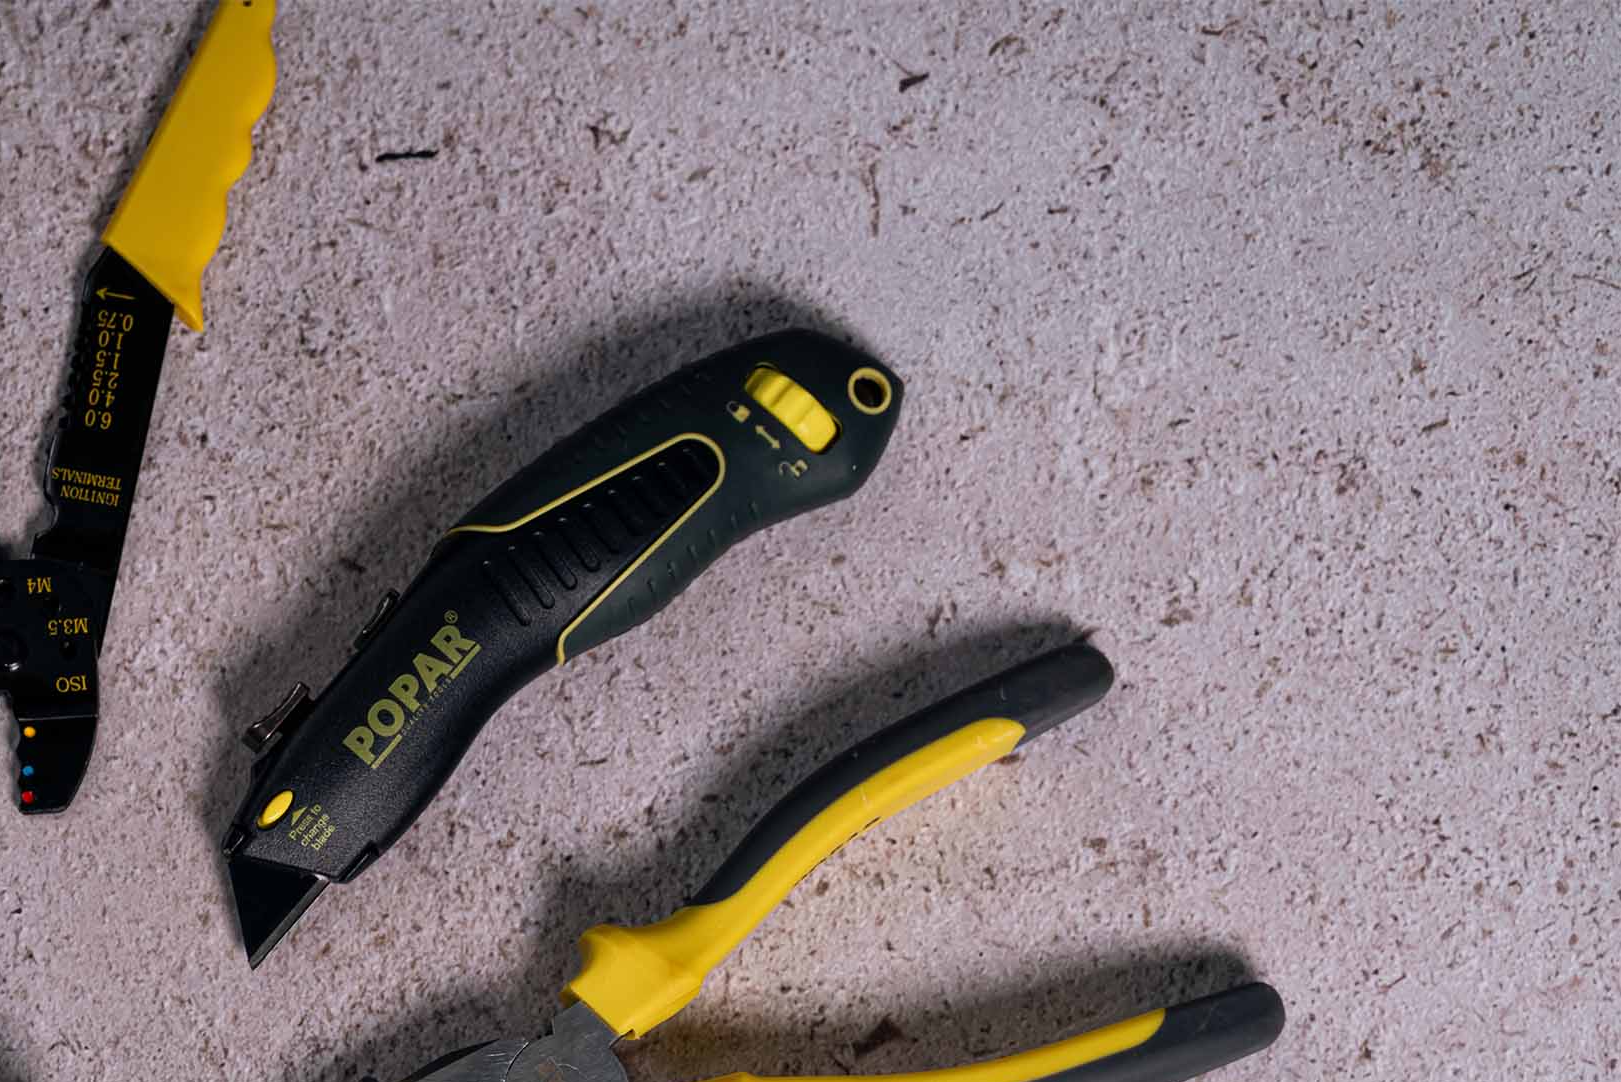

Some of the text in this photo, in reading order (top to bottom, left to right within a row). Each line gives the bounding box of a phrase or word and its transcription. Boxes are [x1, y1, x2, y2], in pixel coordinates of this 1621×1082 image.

[97, 308, 134, 332] 0.75
[98, 331, 125, 351] 1.0
[95, 350, 119, 370] 1.5
[92, 368, 119, 388] 2.5
[88, 388, 116, 409] 4.0
[85, 409, 113, 429] 6.0
[52, 467, 122, 490] TERMINALS
[60, 486, 119, 507] IGNITION
[27, 577, 51, 593] M4
[48, 618, 88, 635] M3.5
[56, 676, 87, 693] ISO
[288, 804, 322, 840] Press to
[301, 814, 330, 846] change
[311, 825, 335, 850] blade
